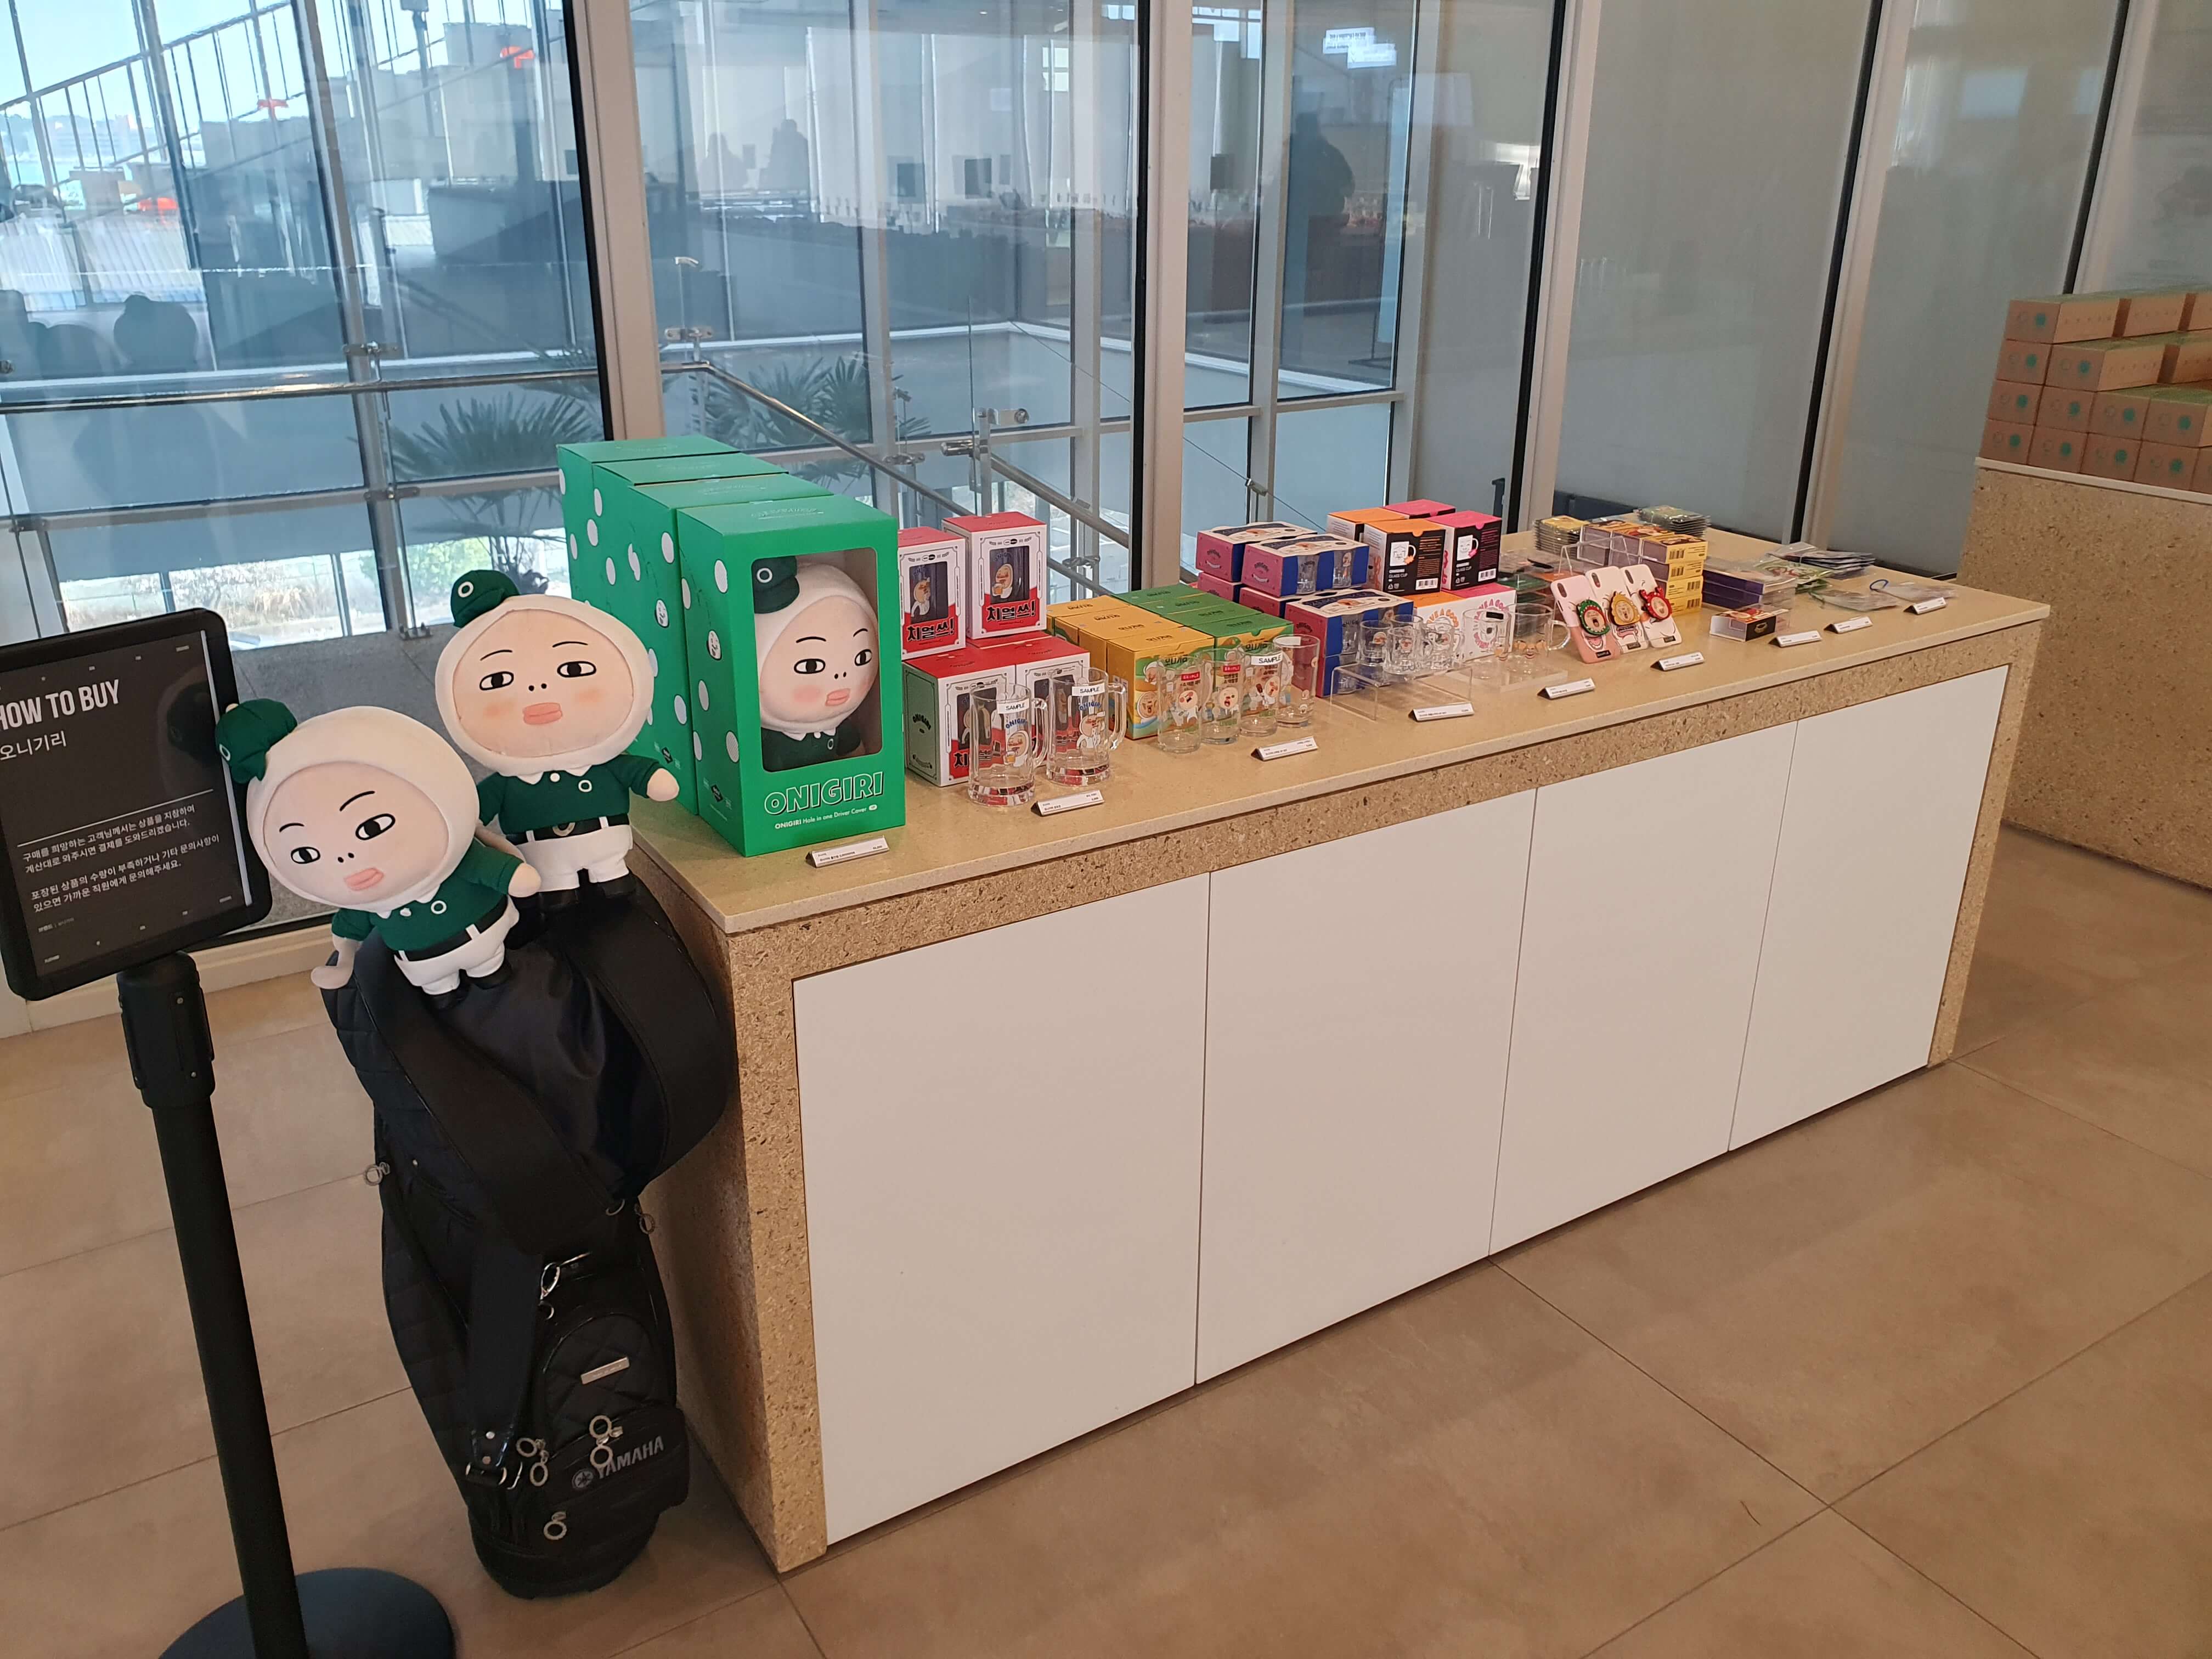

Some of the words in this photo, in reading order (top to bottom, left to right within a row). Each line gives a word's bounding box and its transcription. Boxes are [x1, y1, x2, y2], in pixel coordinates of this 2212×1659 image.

[987, 600, 1036, 622] 치얼쓰!
[907, 618, 955, 643] 치얼쓰!
[1259, 654, 1281, 663] SAMPLE
[45, 690, 75, 719] TO
[78, 679, 119, 712] BUY
[1006, 702, 1025, 710] SAMPLE
[0, 731, 66, 760] 오니기리
[764, 771, 884, 815] ONIGIRI
[23, 848, 49, 861] 구매를
[51, 838, 86, 854] 희망하는
[88, 823, 137, 843] 고객님께서는
[139, 814, 162, 828] 상품을
[165, 804, 195, 820] 지참하여
[775, 819, 802, 830] ONIGIRI
[25, 857, 61, 873] 계산대로
[62, 846, 97, 862] 와주시면
[125, 819, 190, 844] 도와드리겠습니다.
[31, 884, 59, 900] 포장된
[61, 875, 88, 891] 상품의
[90, 867, 116, 881] 수량이
[119, 853, 160, 873] 부족하거나
[162, 847, 178, 859] 기타
[180, 834, 219, 854] 문의사항이
[33, 898, 61, 913] 있으면
[63, 888, 91, 902] 가까운
[92, 876, 127, 893] 직원에게
[129, 860, 182, 882] 문의해주세요.
